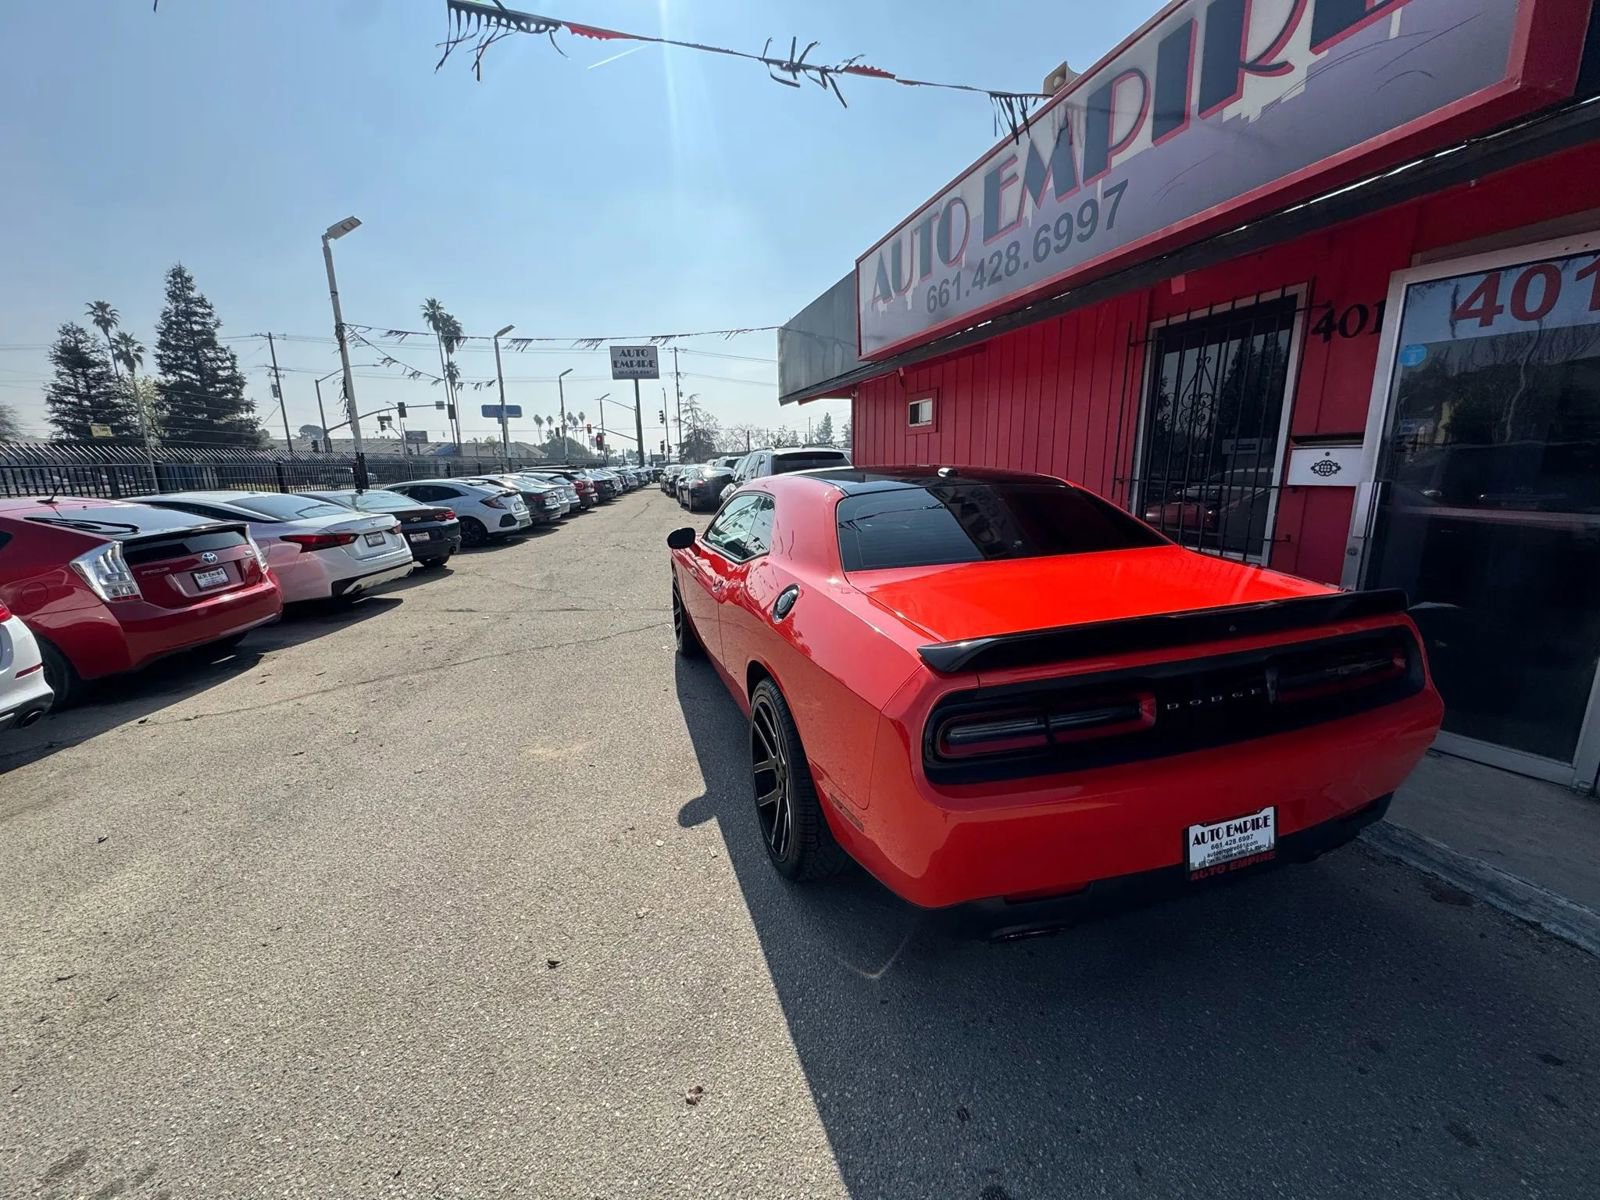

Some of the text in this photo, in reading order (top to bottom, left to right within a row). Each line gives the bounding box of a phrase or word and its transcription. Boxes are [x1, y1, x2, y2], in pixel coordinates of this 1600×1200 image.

[871, 197, 970, 306] AUTO
[926, 178, 1129, 313] 661.428.6997
[613, 360, 656, 368] EMPIRE
[620, 349, 649, 357] AUTO
[1192, 815, 1271, 847] AUTO EMPIRE
[1190, 865, 1226, 881] AUTO
[1229, 851, 1276, 870] EMPIRE
